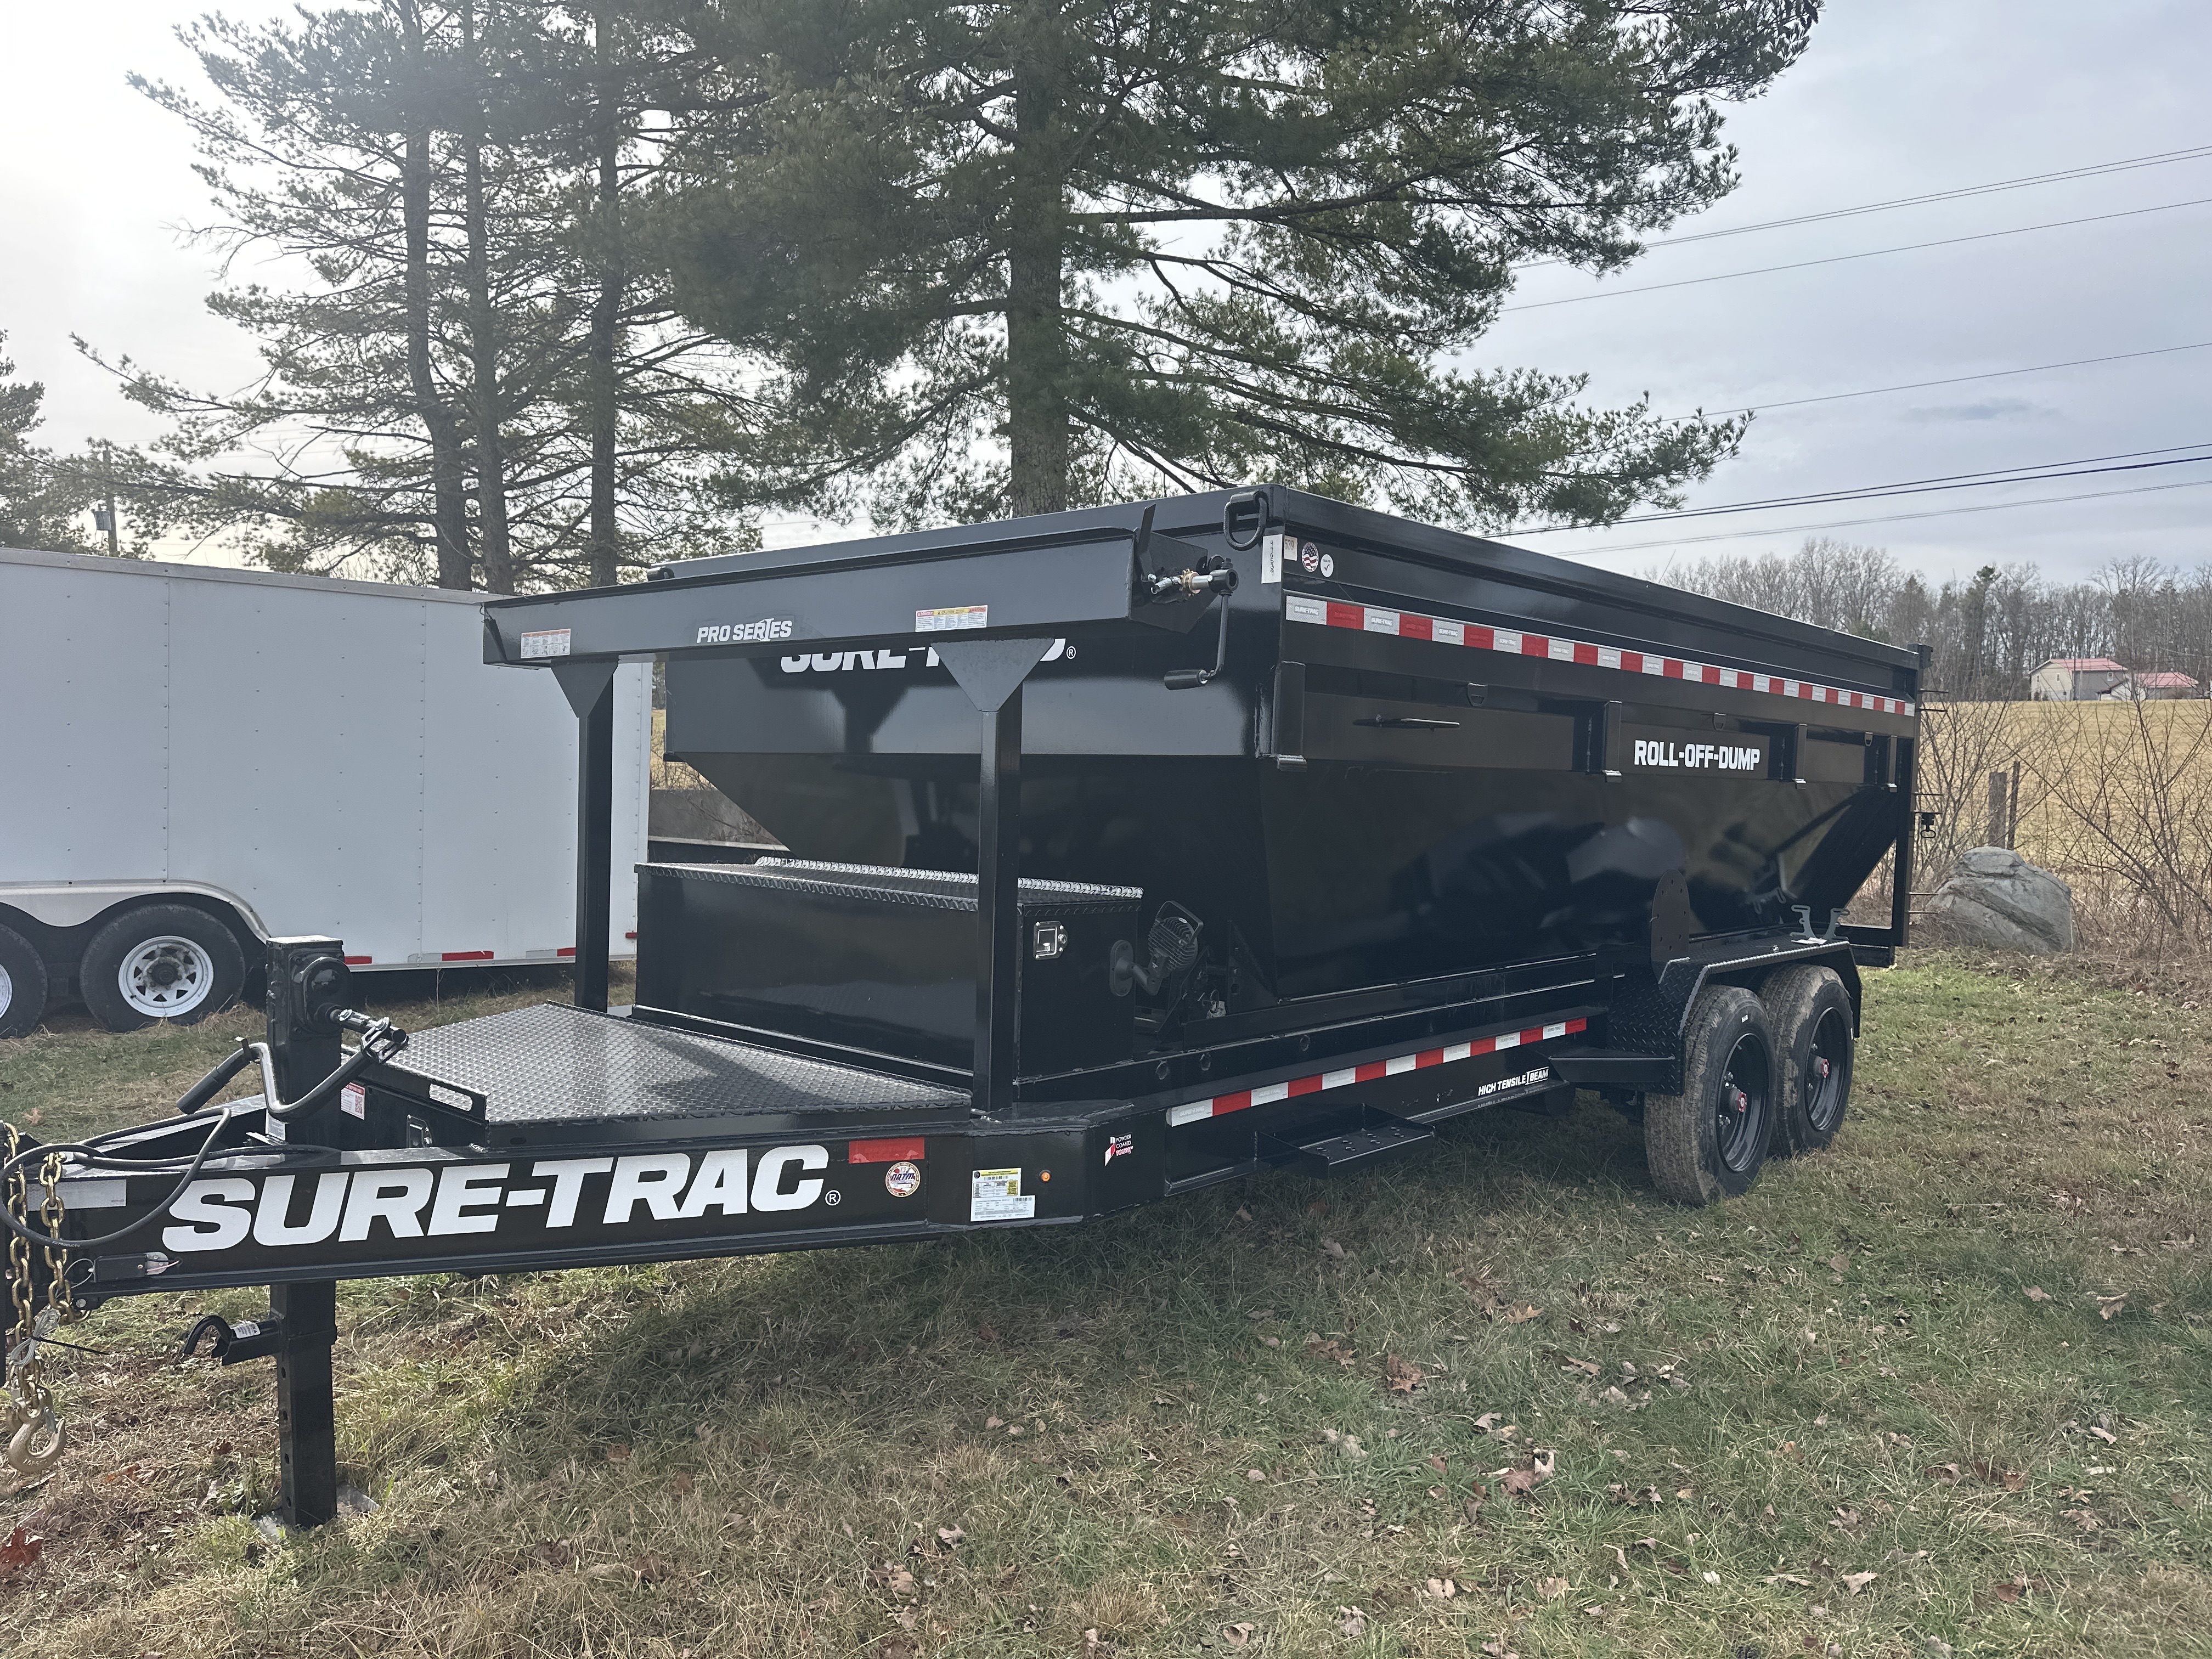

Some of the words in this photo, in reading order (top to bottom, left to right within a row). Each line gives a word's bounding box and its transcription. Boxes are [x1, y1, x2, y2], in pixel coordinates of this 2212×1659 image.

[1284, 539, 1295, 551] 539
[1295, 606, 1319, 616] SURE-TRAC
[1371, 617, 1393, 627] SURE-TRAC
[696, 625, 731, 644] PRO
[732, 618, 792, 641] SERIES
[1634, 740, 1760, 770] ROLL-OFF-DUMP
[1478, 1082, 1496, 1096] HIGH
[1497, 1074, 1526, 1090] TENSILE
[1530, 1069, 1549, 1081] BEAM
[1116, 1134, 1131, 1142] POWDER
[1116, 1140, 1131, 1149] COATED
